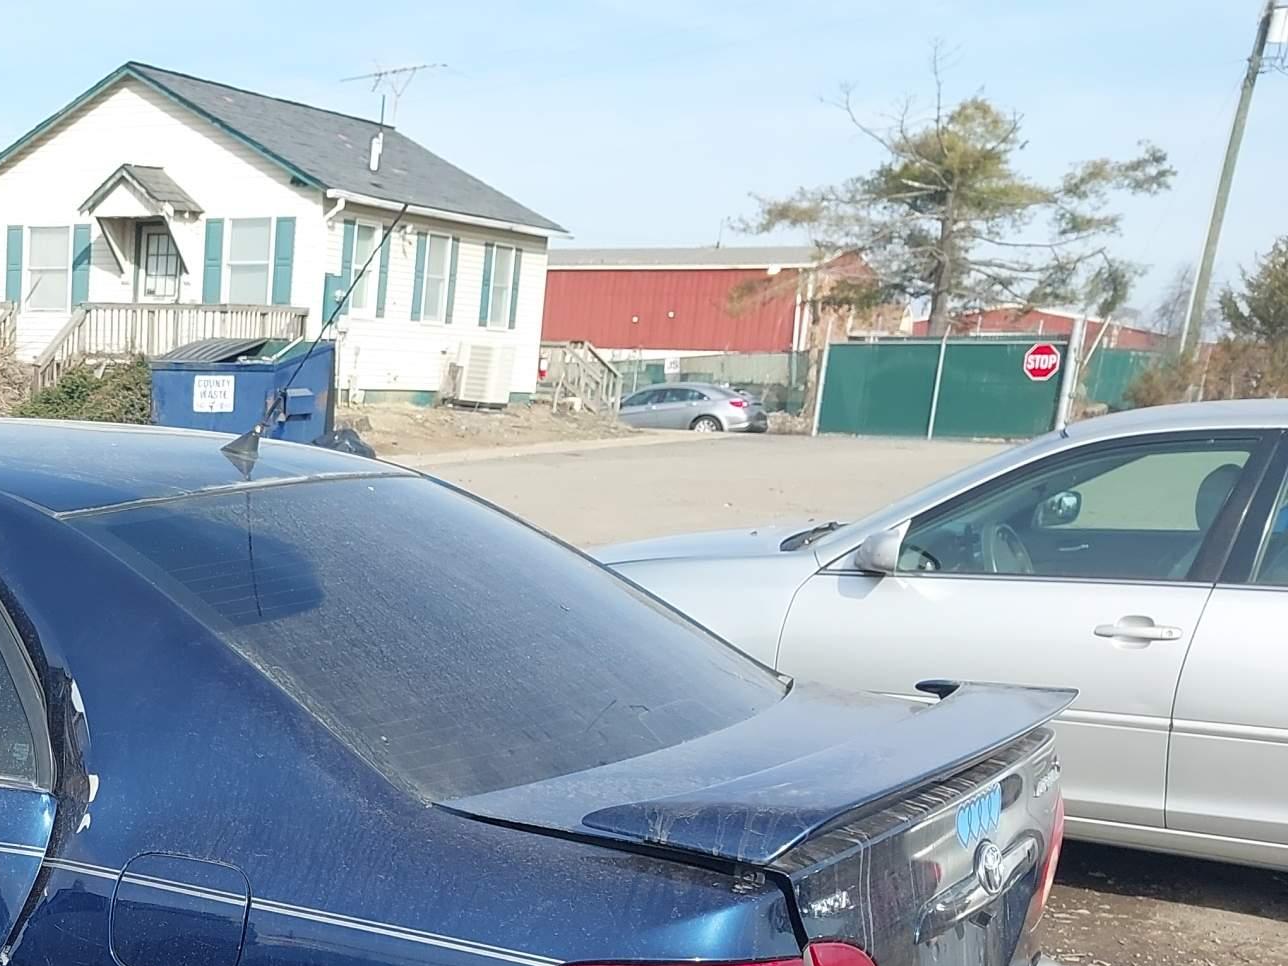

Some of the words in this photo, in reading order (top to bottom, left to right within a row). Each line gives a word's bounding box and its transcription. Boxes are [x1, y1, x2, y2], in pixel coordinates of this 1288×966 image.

[1027, 354, 1057, 370] STOP
[197, 379, 231, 388] COUNTY
[199, 390, 228, 400] WASTE
